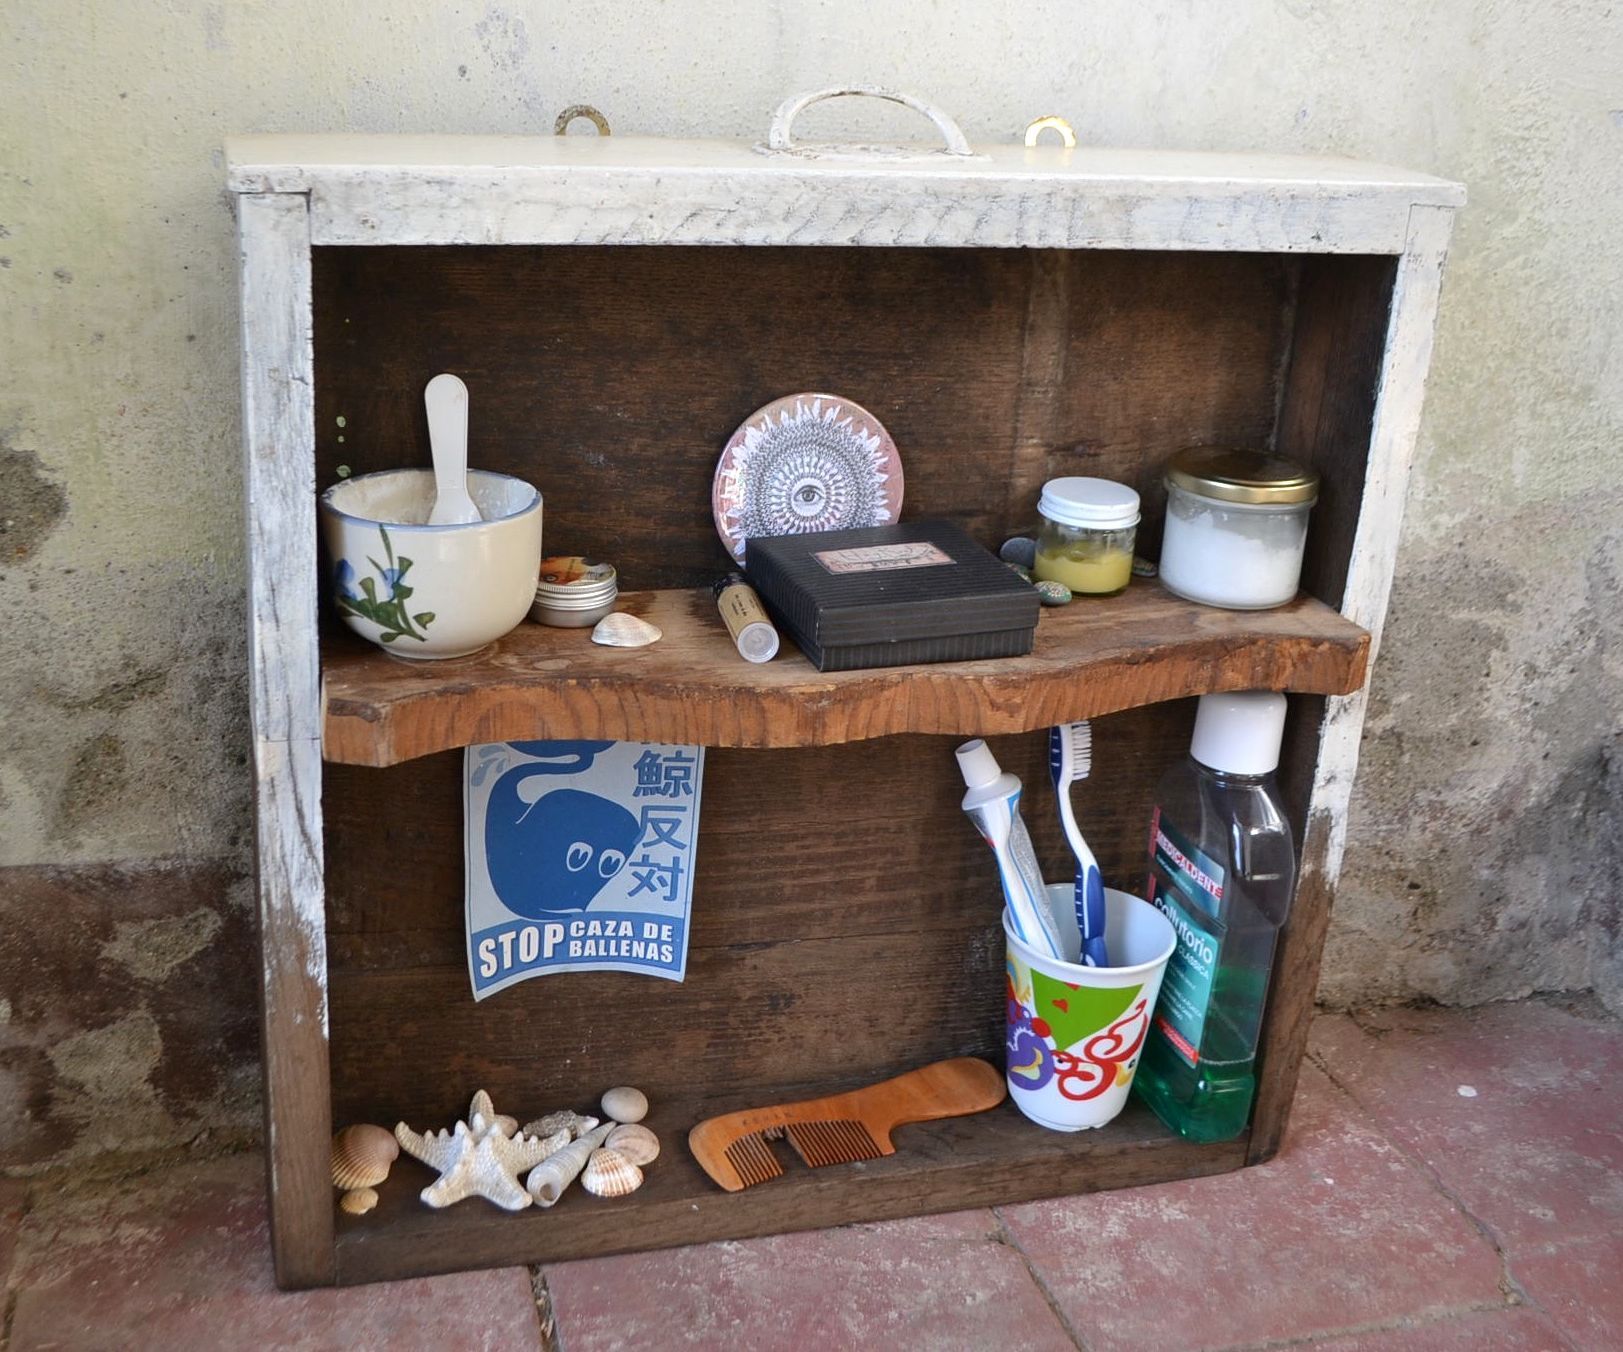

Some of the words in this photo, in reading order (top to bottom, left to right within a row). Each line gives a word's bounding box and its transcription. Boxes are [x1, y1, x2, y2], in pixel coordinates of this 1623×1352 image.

[628, 742, 695, 902] 鯨反対
[478, 923, 565, 978] STOP
[569, 920, 634, 938] CAZA
[643, 922, 673, 942] DE
[569, 939, 673, 963] BALLENAS
